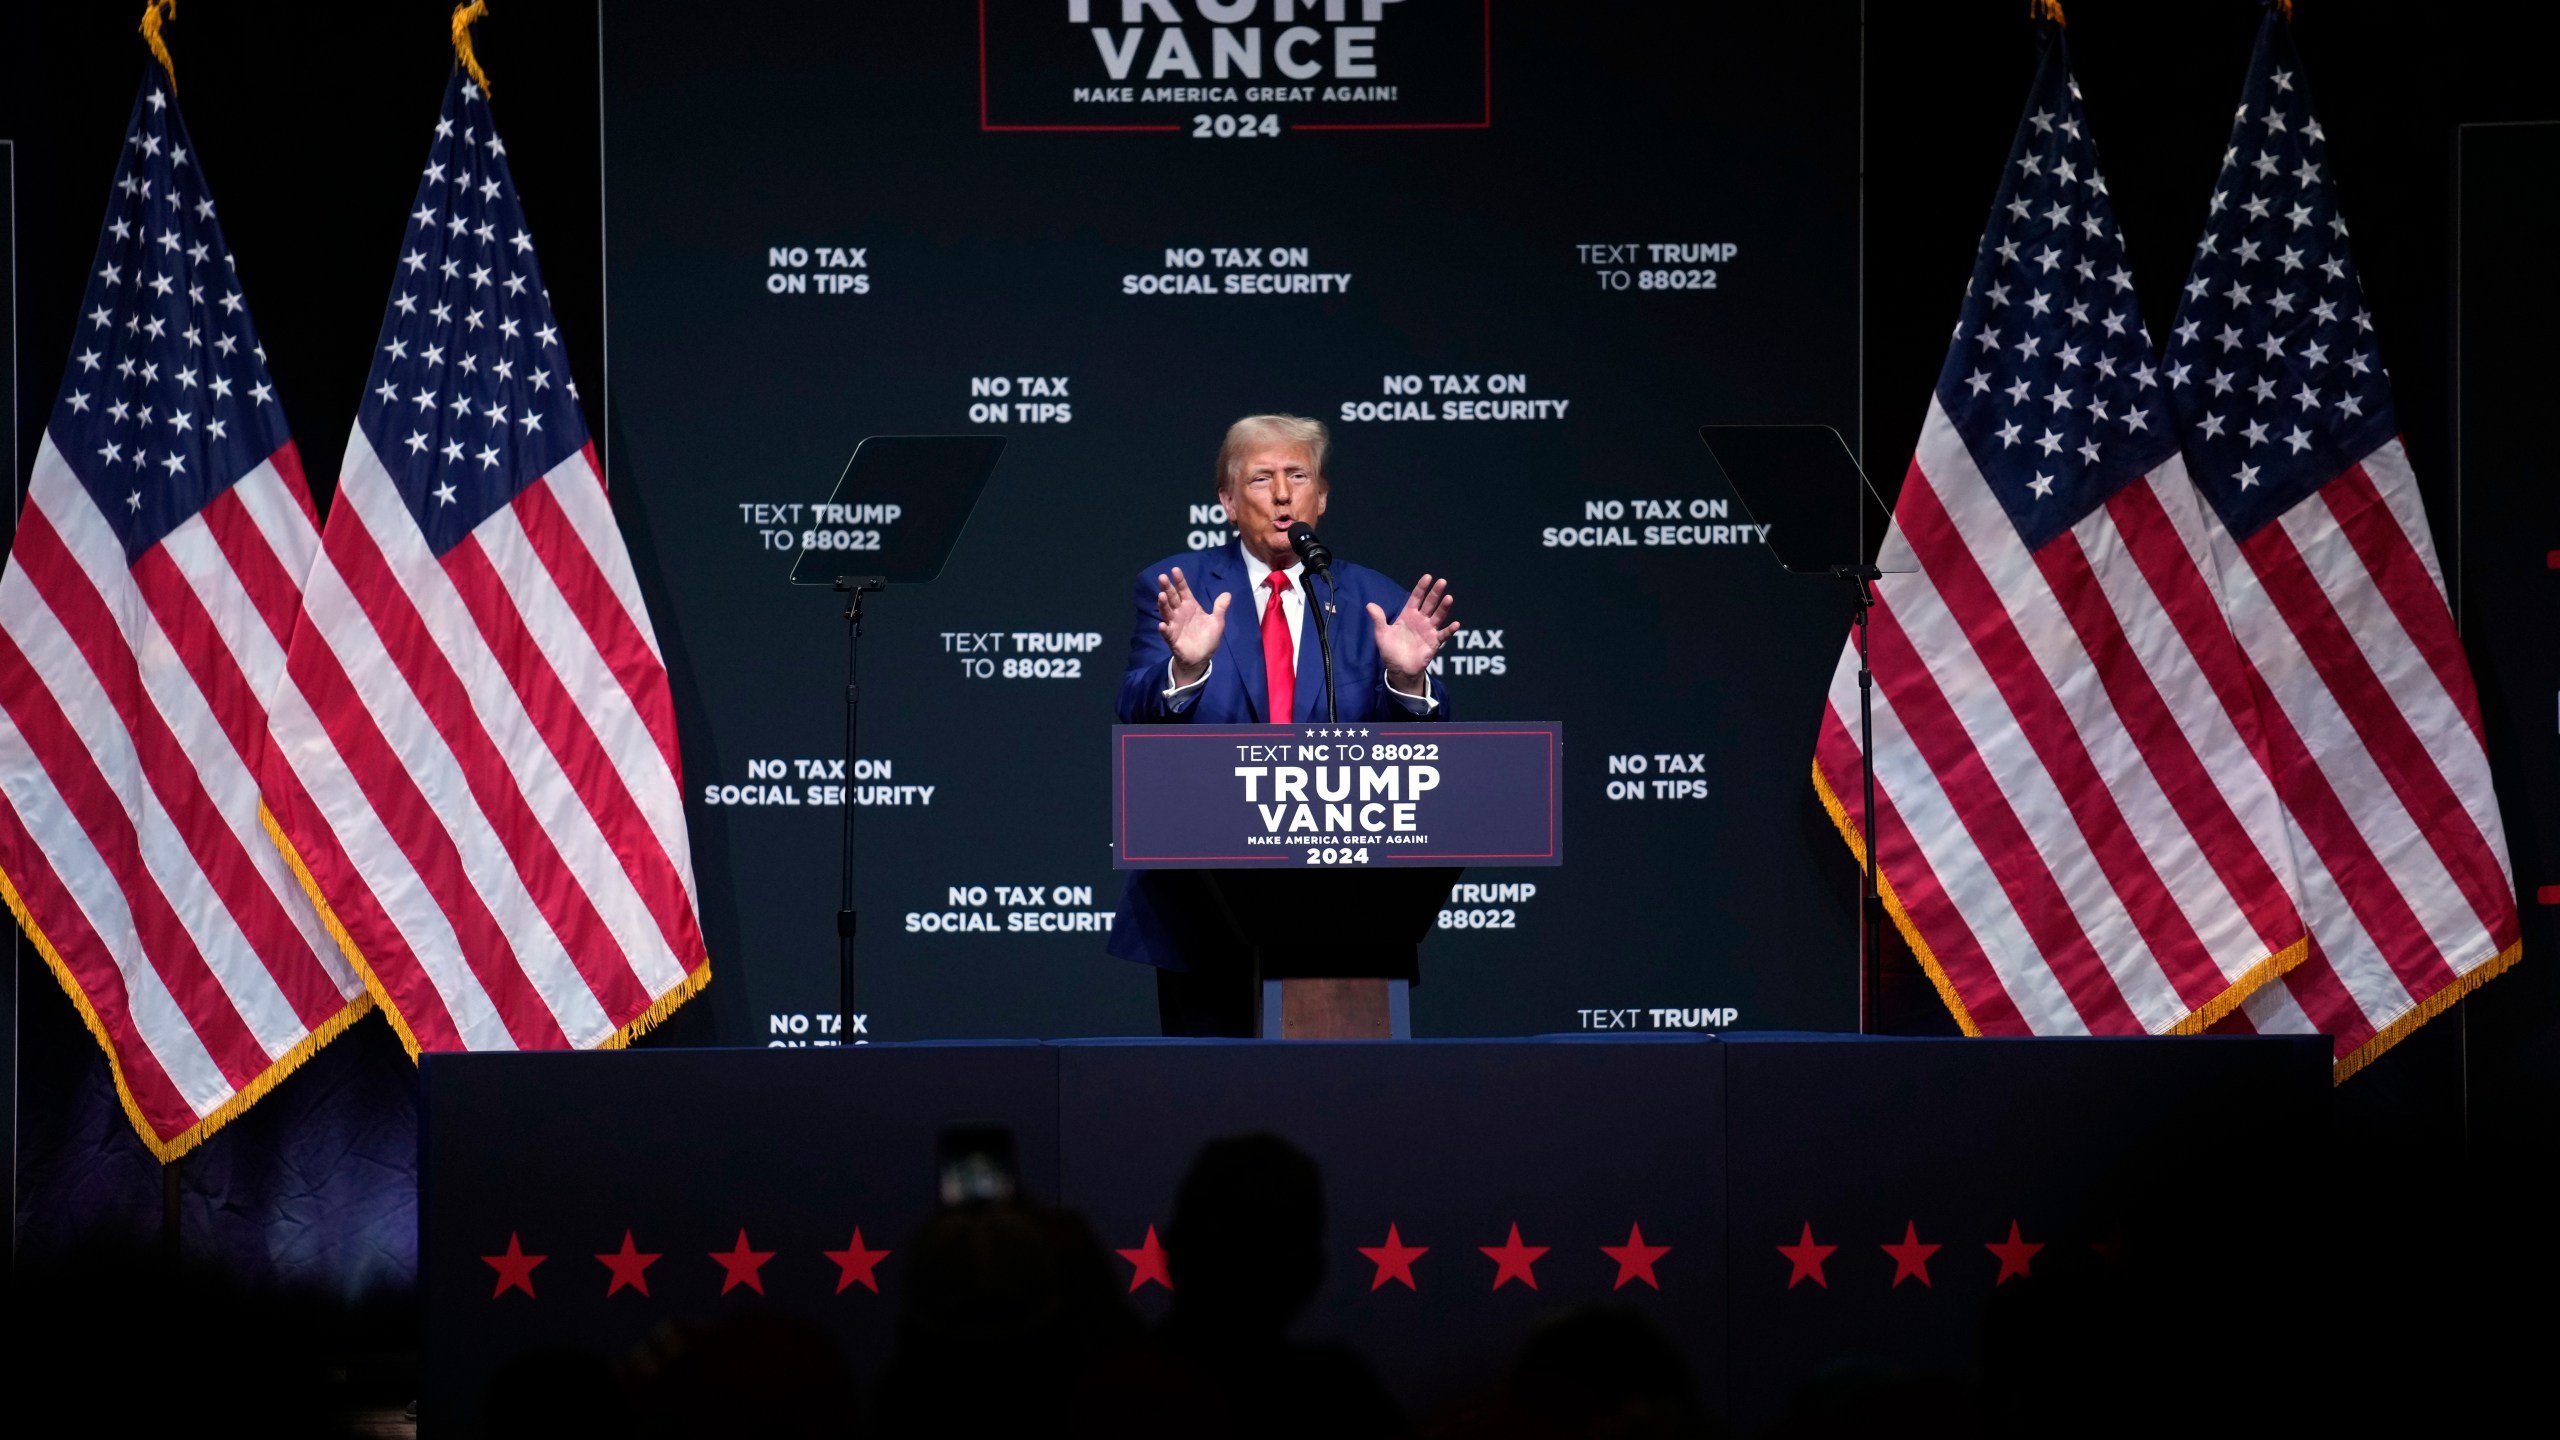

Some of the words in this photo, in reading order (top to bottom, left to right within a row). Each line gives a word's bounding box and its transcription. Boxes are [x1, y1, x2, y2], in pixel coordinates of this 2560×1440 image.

[1091, 26, 1376, 80] VANCE
[1074, 88, 1133, 102] MAKE
[1141, 87, 1238, 102] AMERICA
[1245, 87, 1315, 102] GREAT
[1322, 86, 1397, 101] AGAIN!
[1193, 114, 1280, 138] 2024
[769, 247, 808, 267] NO
[815, 248, 867, 267] TAX
[1166, 248, 1205, 268] NO
[1211, 248, 1262, 267] TAX
[1269, 247, 1308, 267] ON
[1576, 244, 1639, 264] TEXT
[1647, 243, 1737, 263] TRUMP
[767, 274, 806, 293] ON
[813, 274, 870, 294] TIPS
[1123, 274, 1218, 294] SOCIAL
[1224, 274, 1351, 294] SECURITY
[1597, 271, 1630, 290] TO
[1638, 269, 1716, 290] 88022
[972, 377, 1011, 397] NO
[1017, 377, 1068, 397] TAX
[1384, 375, 1422, 395] NO
[1429, 375, 1480, 394] TAX
[1487, 374, 1525, 394] ON
[969, 403, 1008, 423] ON
[1015, 403, 1071, 423] TIPS
[1341, 401, 1436, 421] SOCIAL
[1442, 400, 1569, 420] SECURITY
[739, 504, 803, 524] TEXT
[811, 504, 901, 524] TRUMP
[1190, 504, 1228, 524] NO
[1586, 500, 1624, 520] NO
[1631, 500, 1682, 519] TAX
[1689, 499, 1727, 519] ON
[760, 530, 794, 550] TO
[802, 530, 880, 550] 88022
[1187, 530, 1226, 550] ON
[1543, 527, 1637, 547] SOCIAL
[1644, 525, 1771, 546] SECURITY
[941, 633, 1004, 652] TEXT
[1012, 633, 1102, 652] TRUMP
[1453, 630, 1504, 649] TAX
[961, 658, 994, 678] TO
[1003, 658, 1081, 678] 88022
[1425, 656, 1443, 675] N
[1450, 655, 1506, 675] TIPS
[1237, 746, 1291, 761] TEXT
[1299, 745, 1329, 761] NC
[1336, 745, 1364, 760] TO
[1372, 744, 1438, 760] 88022
[749, 759, 787, 779] NO
[794, 760, 845, 779] TAX
[855, 760, 891, 780] ON
[1609, 755, 1647, 774] NO
[1654, 754, 1705, 773] TAX
[1235, 766, 1440, 802] TRUMP
[1606, 781, 1644, 800] ON
[1652, 780, 1707, 799] TIPS
[705, 785, 799, 806] SOCIAL
[1258, 803, 1416, 832] VANCE
[1248, 836, 1281, 844] MAKE
[1285, 836, 1339, 844] AMERICA
[1343, 836, 1382, 844] GREAT
[1386, 835, 1427, 843] AGAIN!
[1307, 848, 1369, 864] 2024
[949, 887, 987, 906] NO
[994, 887, 1045, 906] TAX
[1053, 886, 1091, 906] ON
[1452, 883, 1536, 903] TRUMP
[905, 912, 1001, 932] SOCIAL
[1008, 912, 1116, 932] SECURIT
[1438, 909, 1515, 929] 88022
[770, 1014, 809, 1034] NO
[1577, 1009, 1641, 1028] TEXT
[1649, 1008, 1738, 1027] TRUMP
